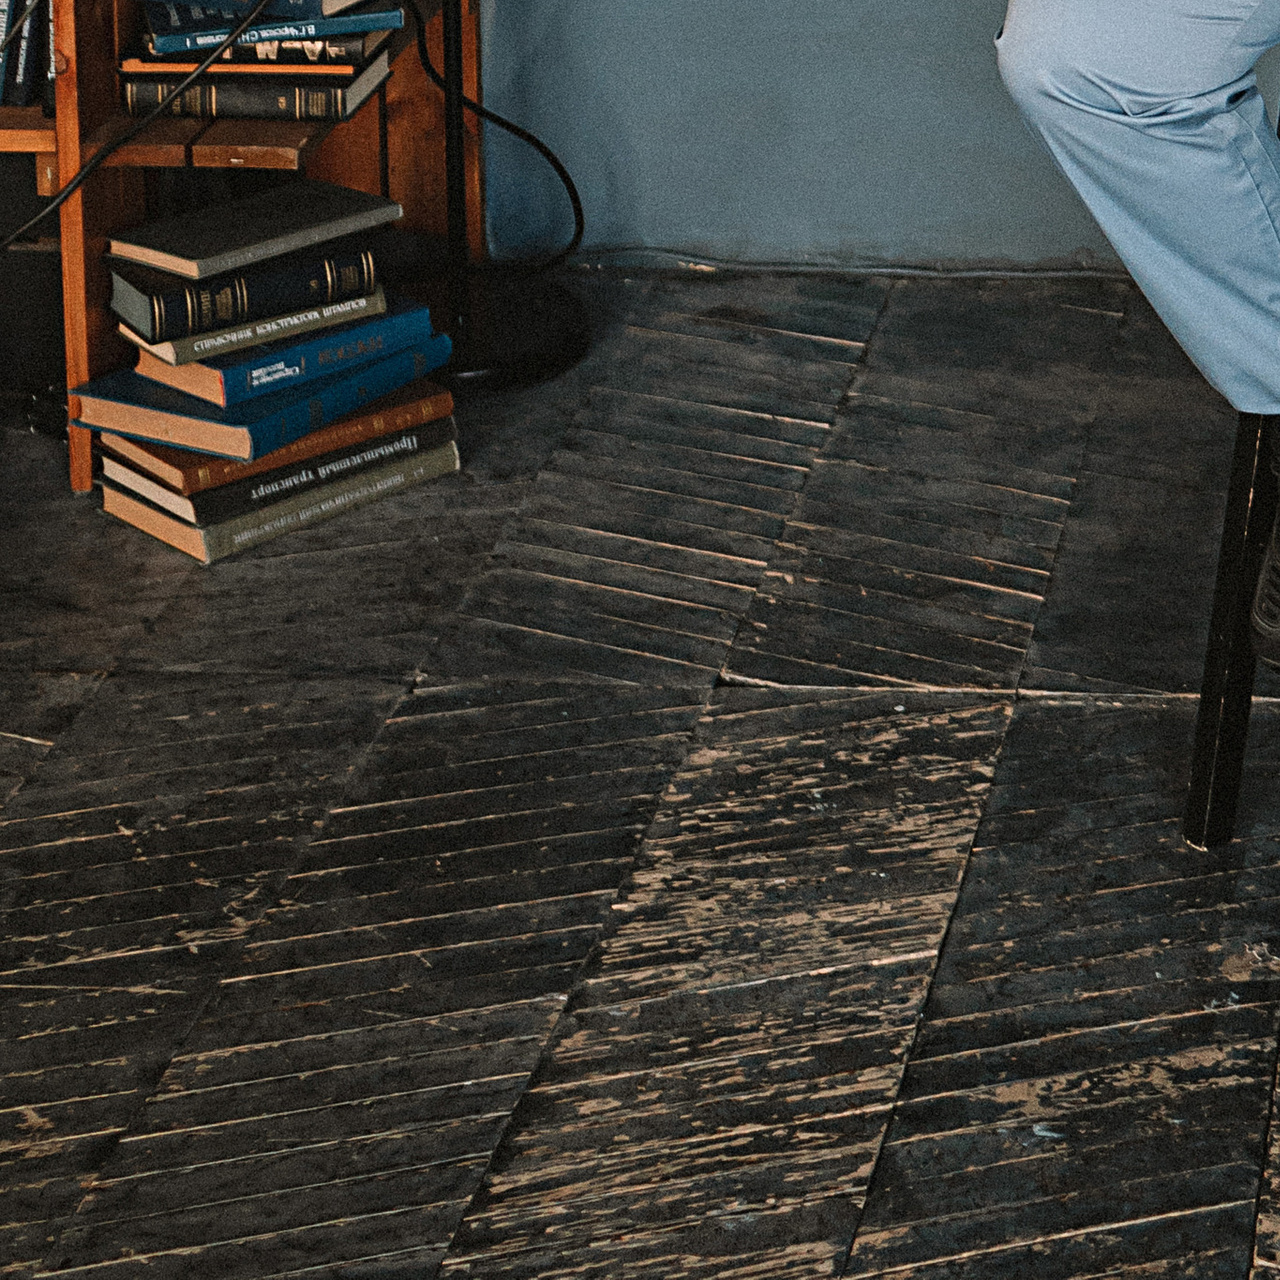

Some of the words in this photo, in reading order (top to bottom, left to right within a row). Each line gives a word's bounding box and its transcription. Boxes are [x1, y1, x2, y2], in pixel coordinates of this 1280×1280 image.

[193, 328, 253, 353] СПРАВОЧНИК
[322, 297, 367, 319] ШТАМПОВ
[317, 434, 419, 479] Промышленный
[250, 468, 316, 500] транспорт
